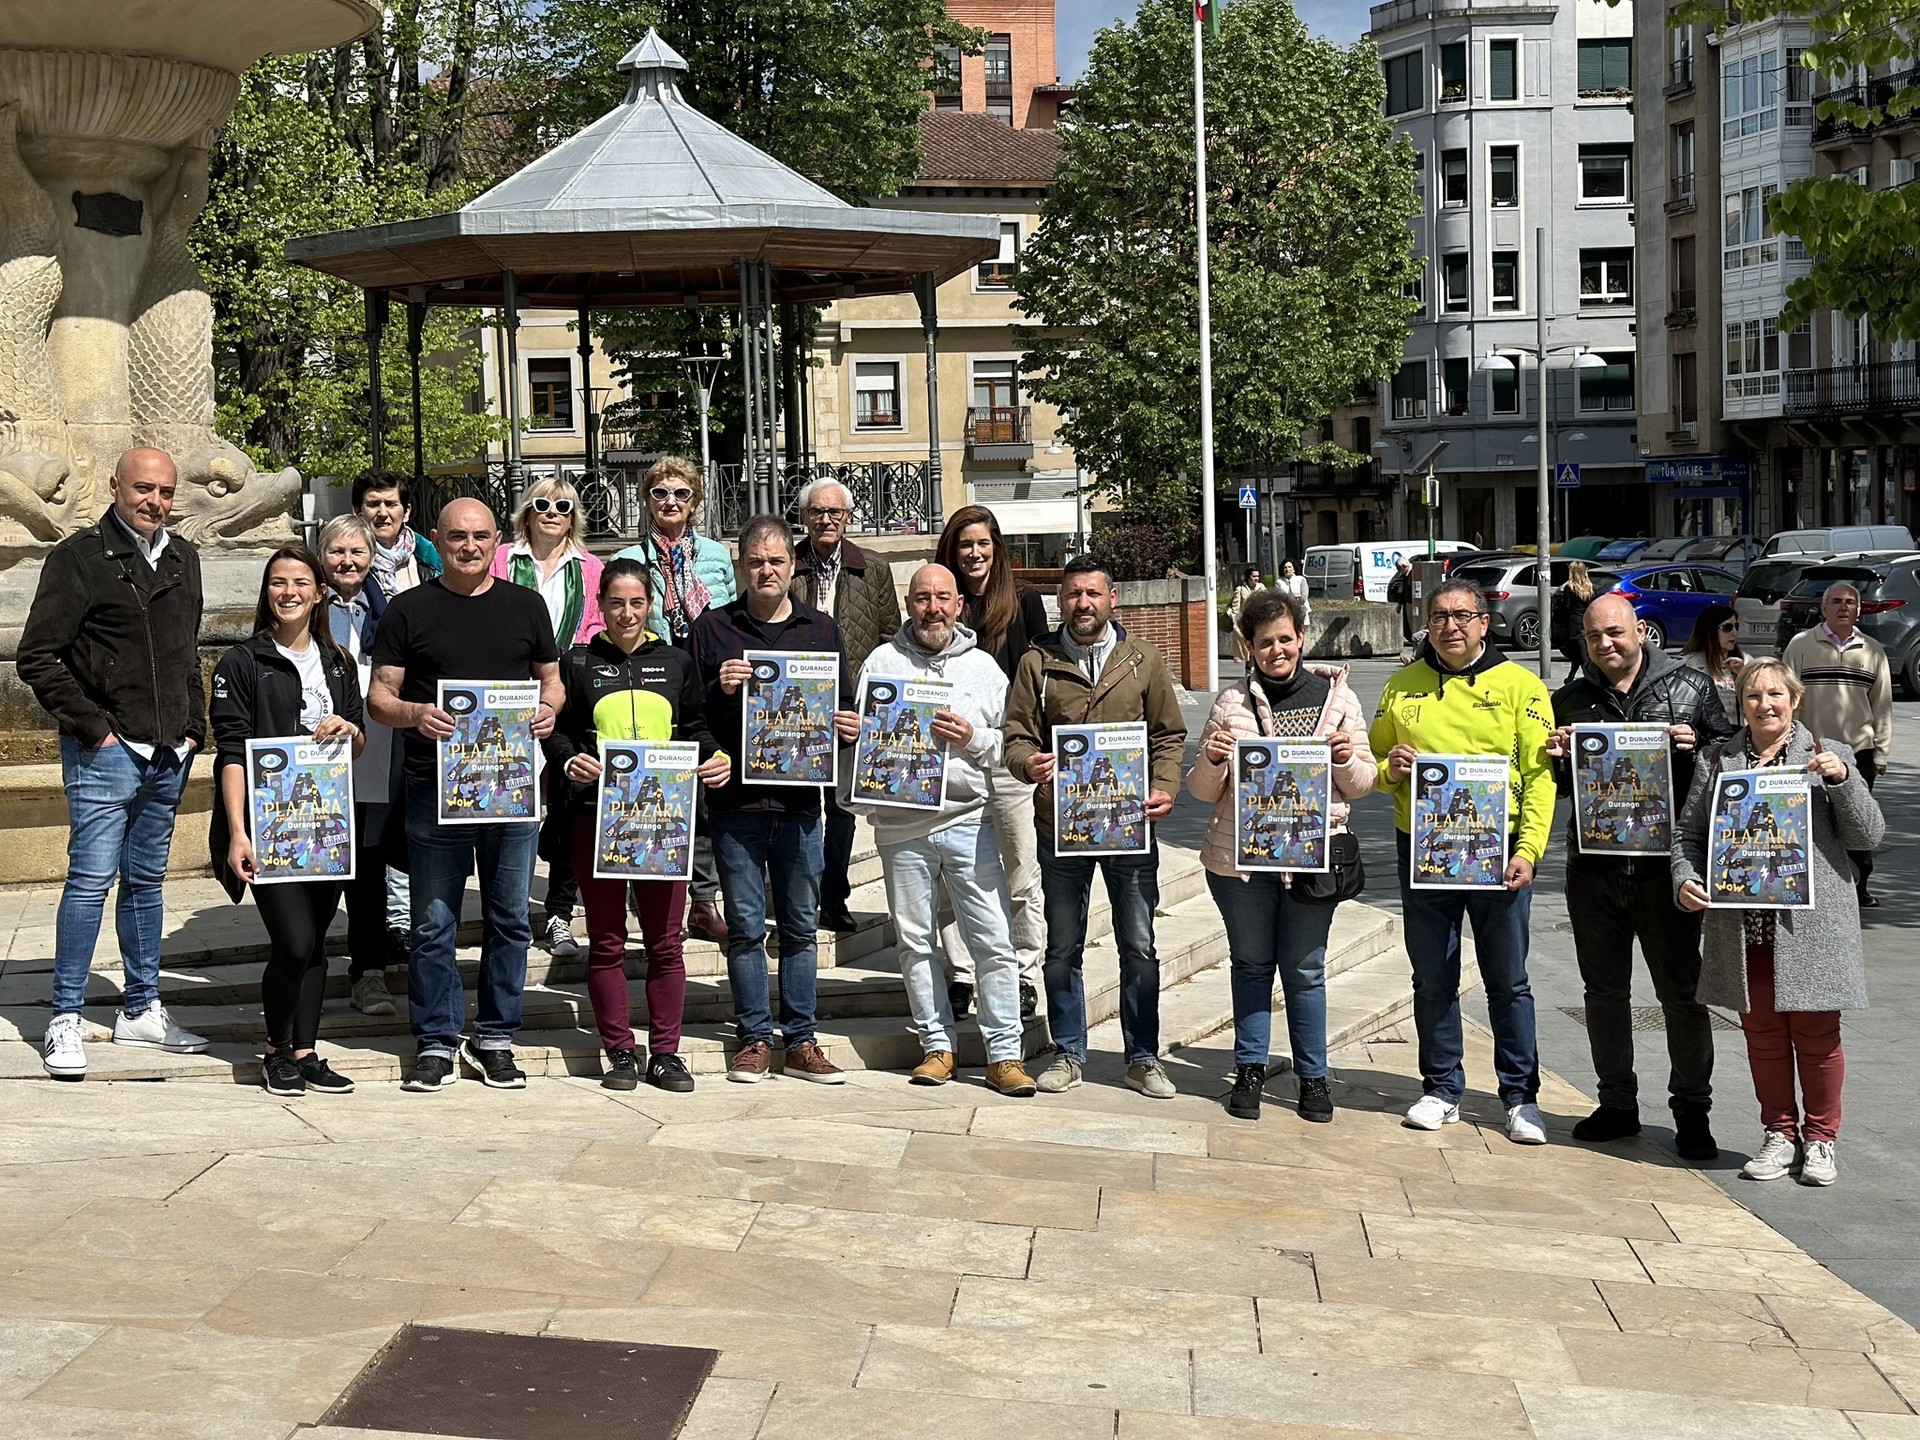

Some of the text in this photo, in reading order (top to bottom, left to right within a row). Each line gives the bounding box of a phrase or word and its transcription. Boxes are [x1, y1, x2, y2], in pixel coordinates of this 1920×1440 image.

[1677, 466, 1704, 477] VIAJES
[917, 689, 949, 697] DURANGO
[756, 710, 826, 726] PLAZARA
[452, 742, 526, 760] PLAZARA
[887, 751, 916, 760] Durango
[472, 764, 504, 772] Durango
[749, 759, 776, 769] WOW
[859, 779, 886, 790] WOW
[1587, 781, 1661, 796] PLAZARA
[1067, 782, 1137, 798] PLAZARA
[446, 798, 474, 807] WOW
[1248, 795, 1319, 811] PLAZARA
[264, 799, 342, 818] PLAZARA
[611, 801, 683, 819] PLAZARA
[288, 821, 321, 829] Durango
[630, 822, 661, 830] Durango
[1424, 813, 1496, 829] PLAZARA
[1062, 832, 1089, 842] WOW
[1444, 833, 1475, 841] Durango
[1585, 831, 1612, 840] WOW
[1722, 828, 1799, 845] PLAZARA
[1242, 847, 1269, 856] WOW
[261, 856, 292, 866] WOW
[602, 853, 630, 863] WOW
[1418, 864, 1445, 873] WOW
[1714, 882, 1746, 892] WOW
